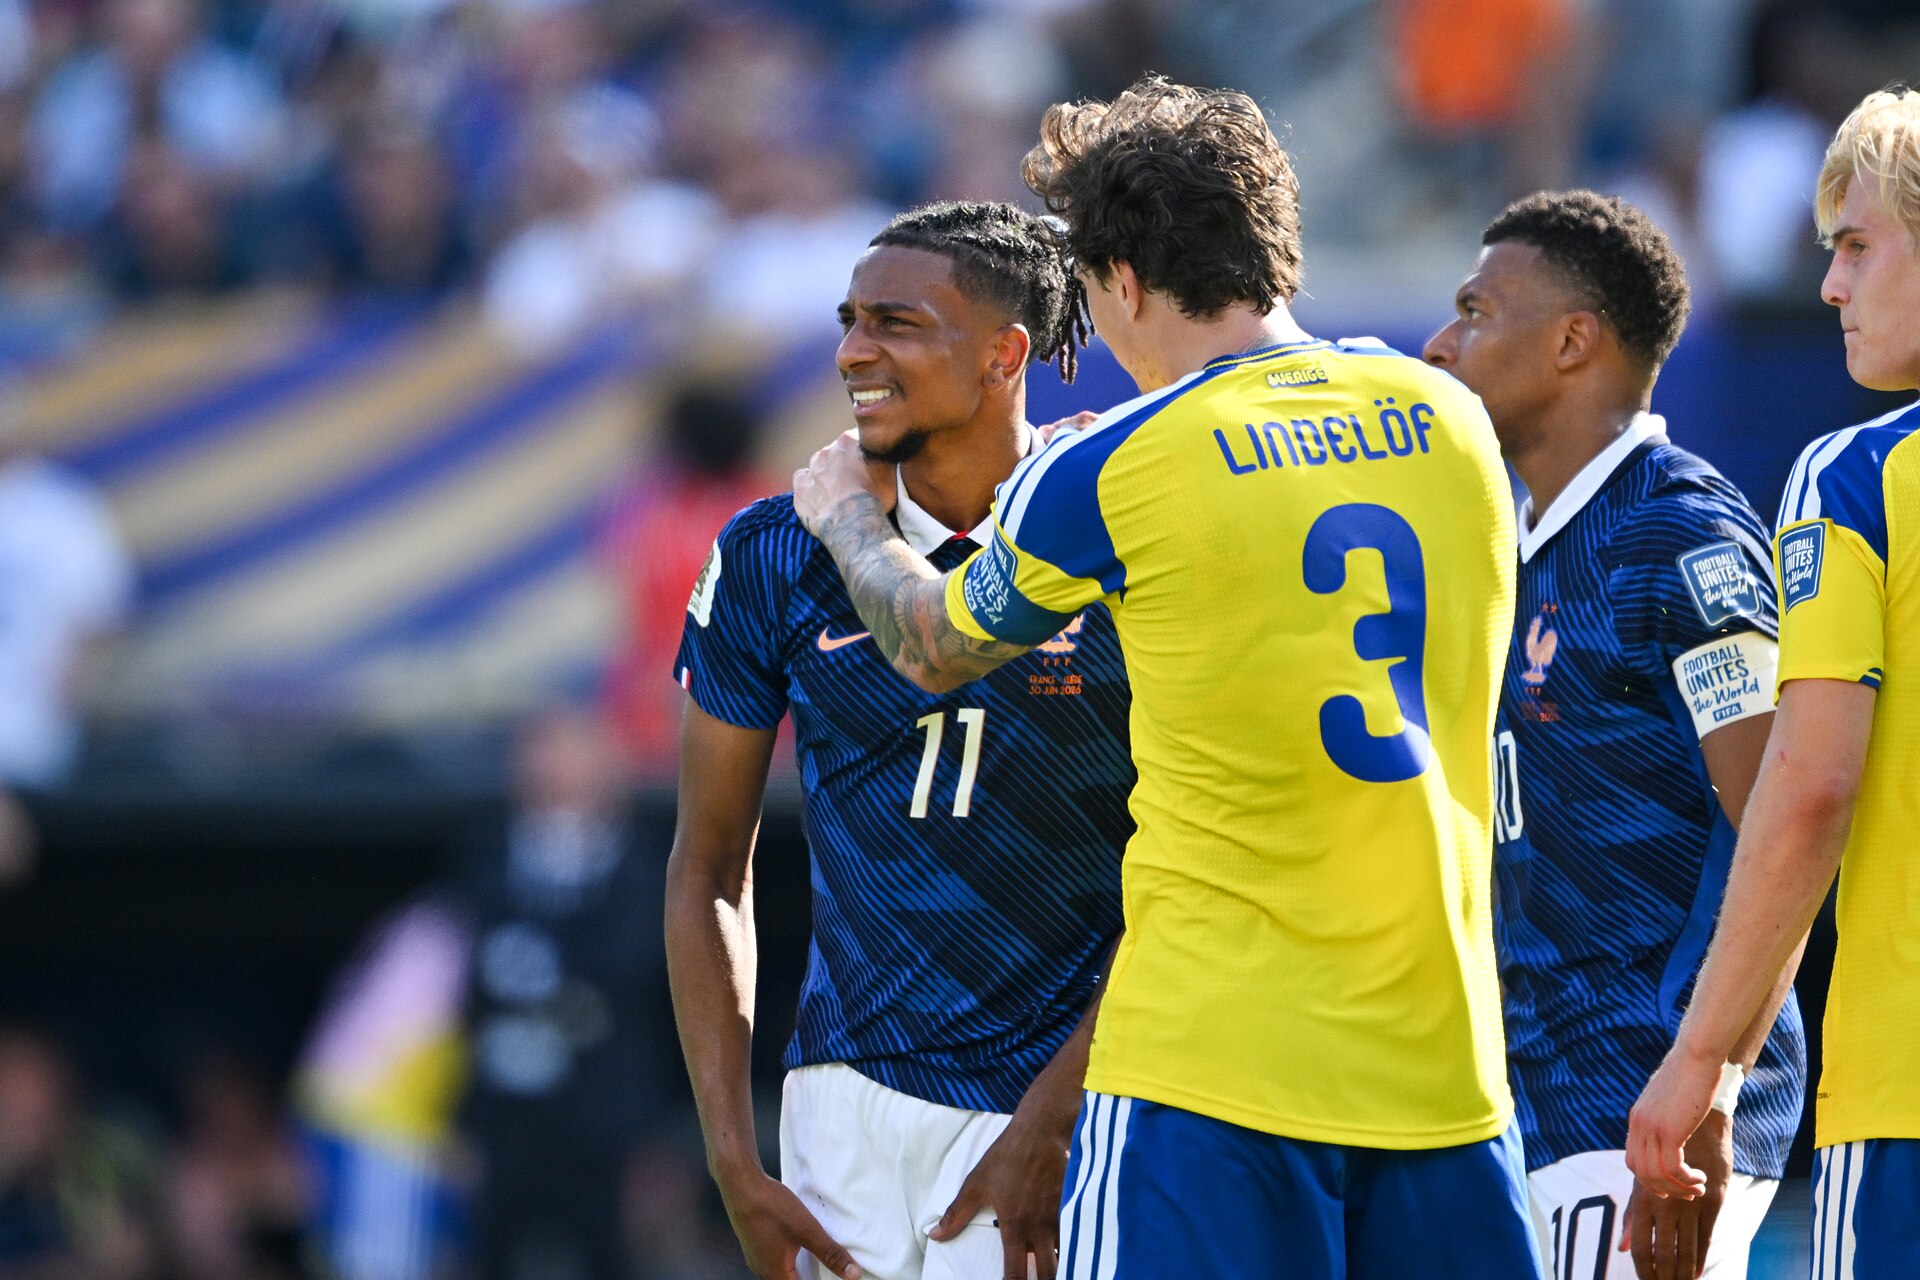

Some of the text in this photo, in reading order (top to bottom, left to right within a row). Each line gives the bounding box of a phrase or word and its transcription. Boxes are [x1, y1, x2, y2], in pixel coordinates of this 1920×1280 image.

[1266, 368, 1328, 388] SVERIGE
[1213, 397, 1435, 475] LINDELÖF
[1785, 537, 1814, 558] FOOTBALL
[1692, 552, 1738, 575] FOOTBALL
[1786, 549, 1814, 574] UNITES
[1697, 564, 1743, 590] UNITES
[973, 576, 1003, 625] World
[1702, 588, 1721, 605] the
[1720, 580, 1749, 598] World
[1303, 503, 1430, 783] 3
[1683, 644, 1743, 677] FOOTBALL
[1029, 674, 1055, 685] FRANCE
[1029, 685, 1042, 695] 30
[1060, 685, 1082, 695] 2026
[1686, 659, 1749, 696] UNITES
[1693, 677, 1760, 715] the World
[1713, 703, 1742, 722] FIFA
[910, 708, 986, 818] 11
[1551, 1194, 1617, 1280] 10
